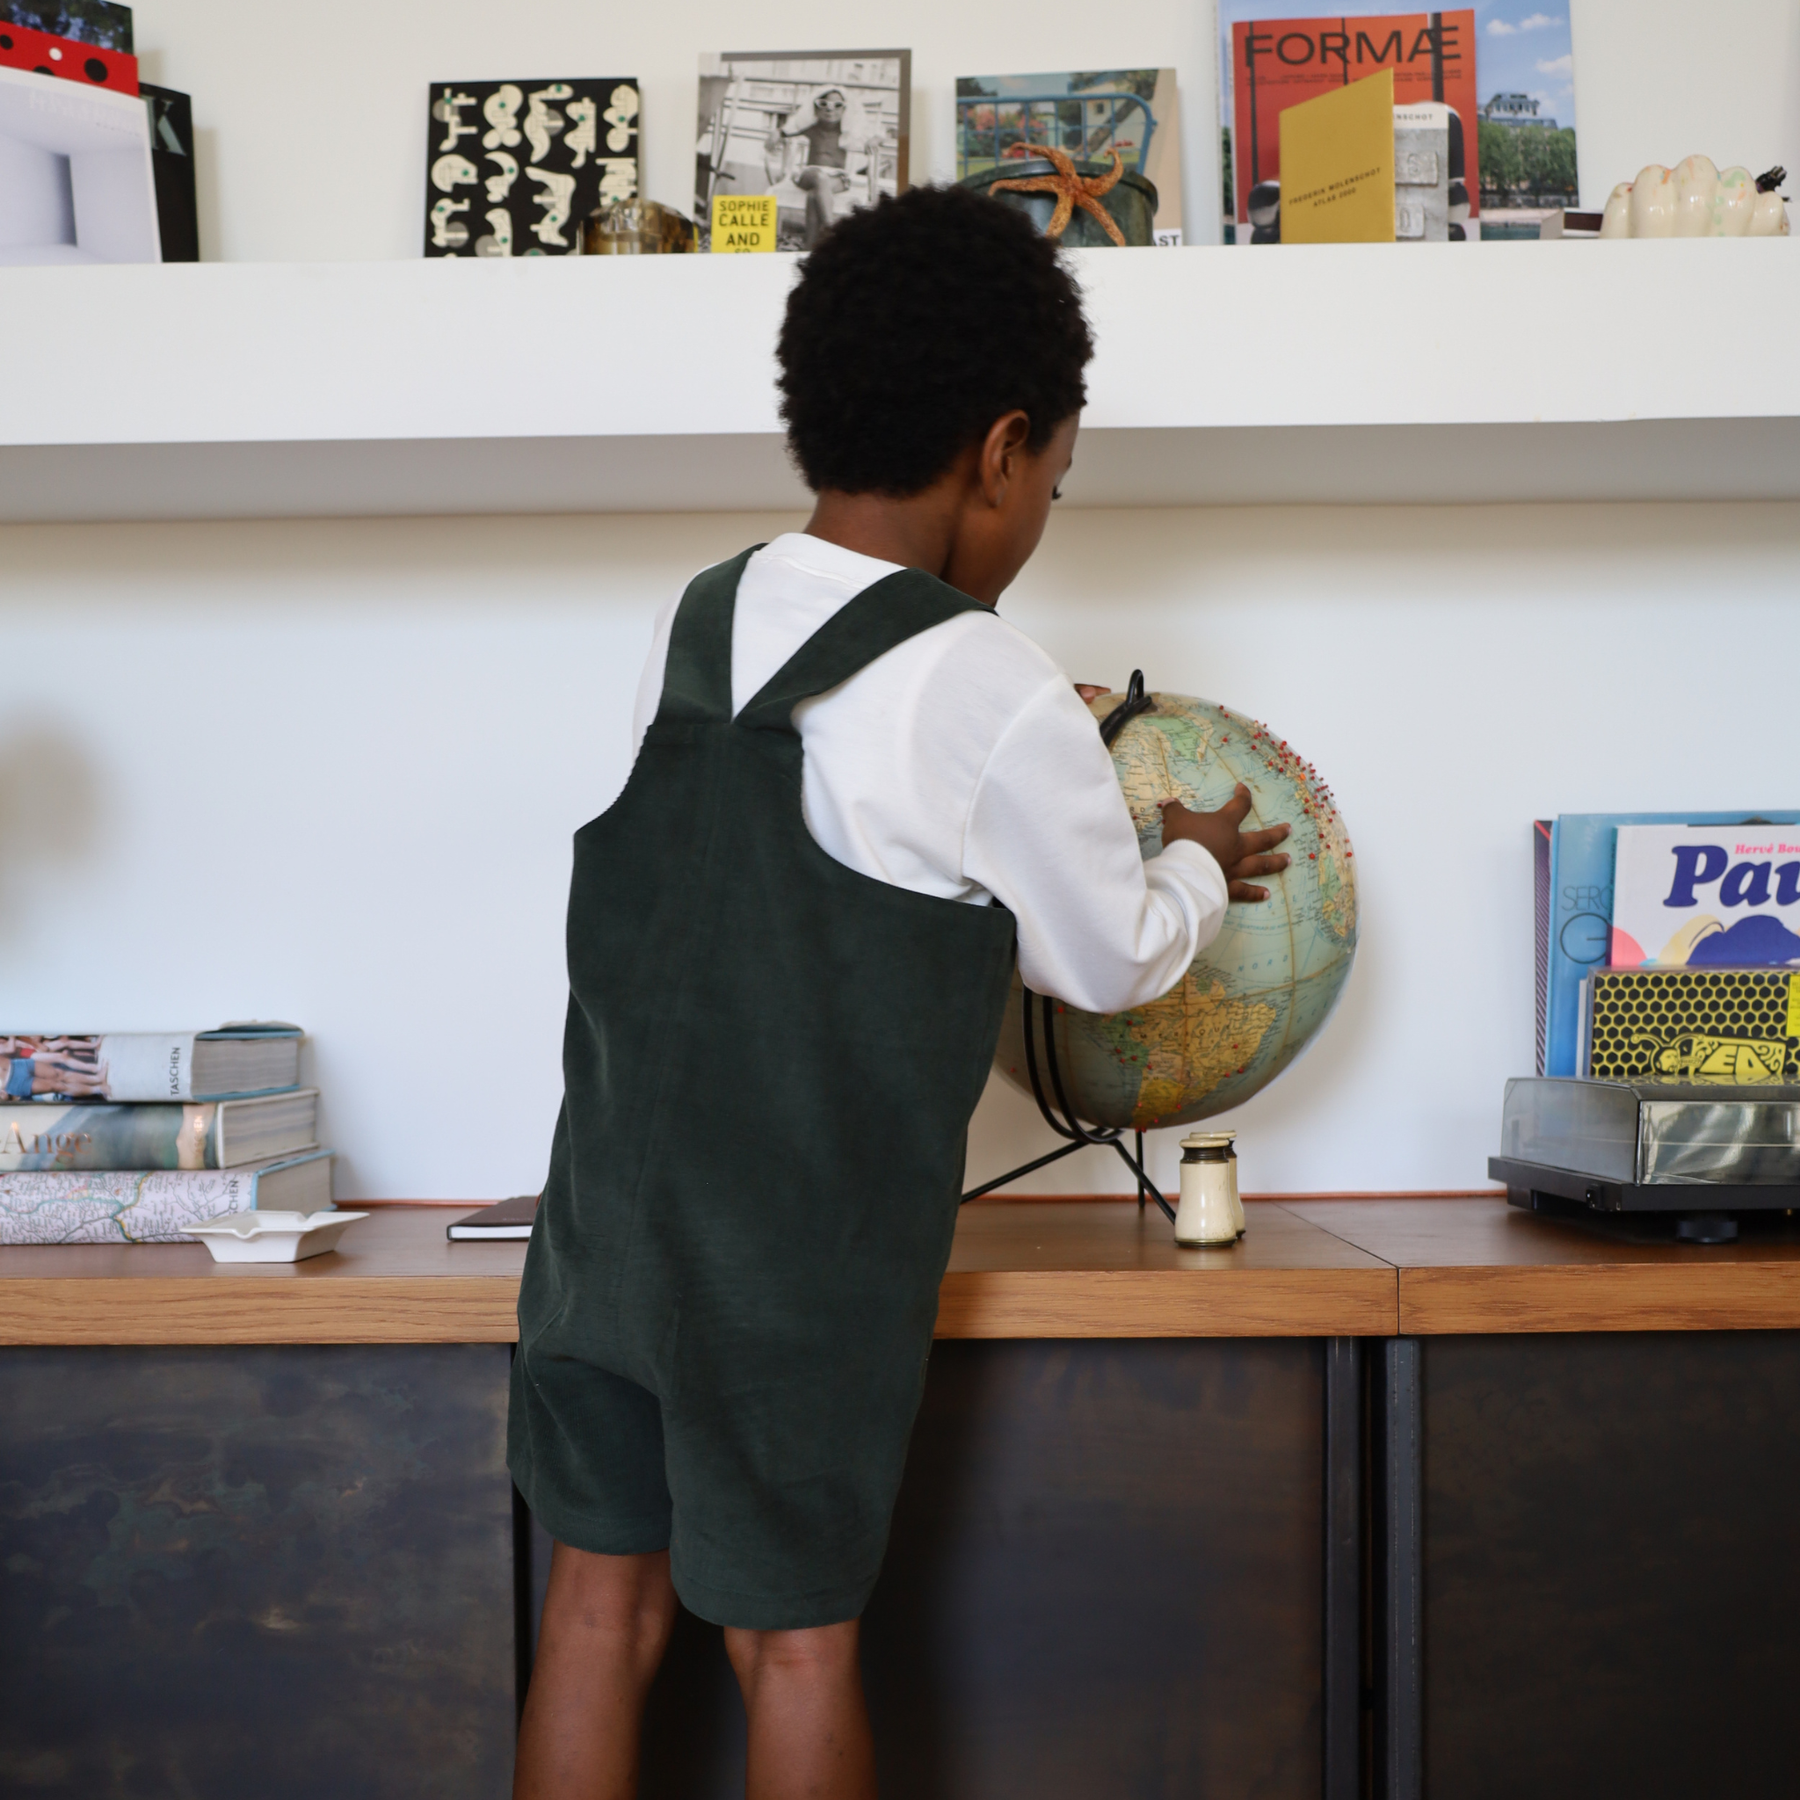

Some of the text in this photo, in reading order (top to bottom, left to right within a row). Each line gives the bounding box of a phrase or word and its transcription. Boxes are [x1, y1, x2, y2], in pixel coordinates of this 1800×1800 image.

[1395, 113, 1433, 121] NSCHOT
[719, 200, 769, 212] SOPHIE
[718, 213, 769, 227] CALLE
[726, 231, 761, 246] AND
[1153, 235, 1180, 247] ST
[1735, 843, 1774, 855] Hervé
[170, 1047, 181, 1096] TASCHEN
[0, 1121, 92, 1164] Ange
